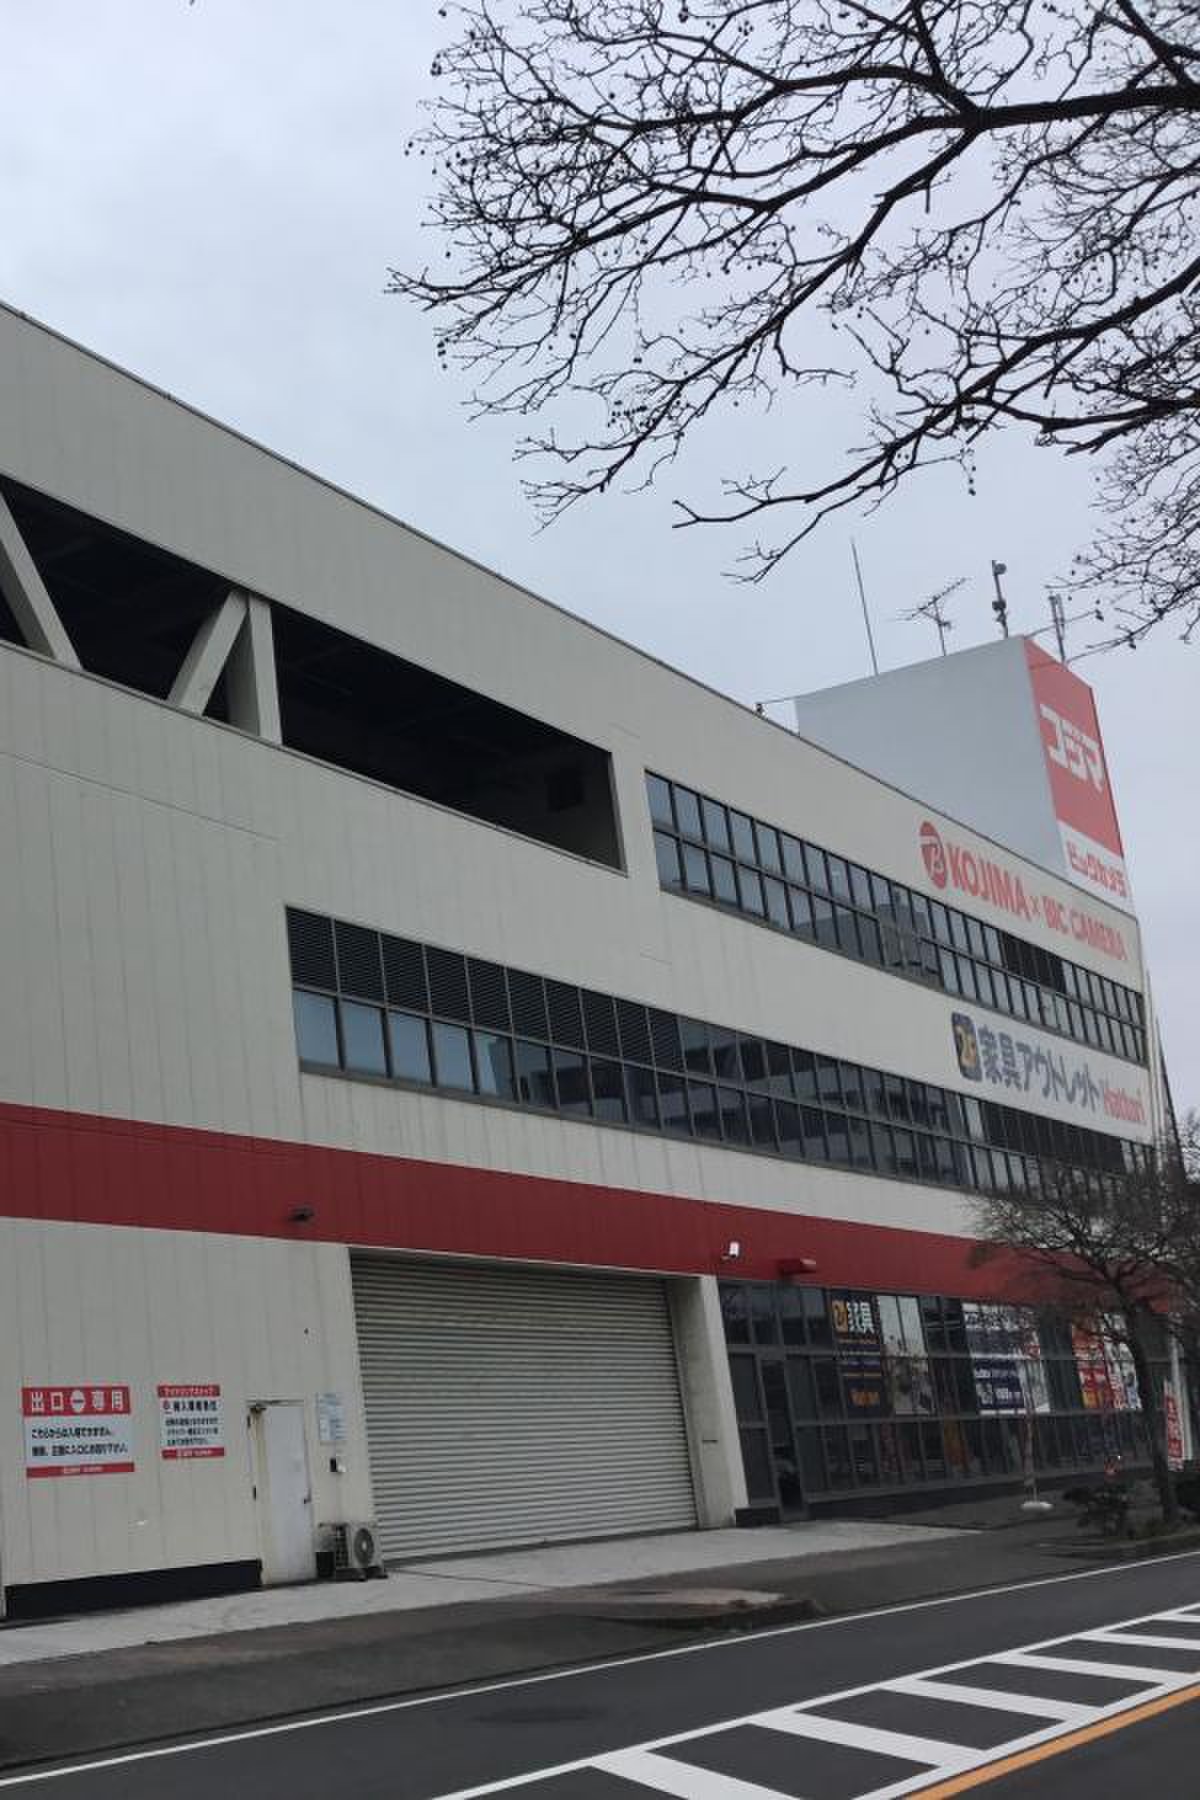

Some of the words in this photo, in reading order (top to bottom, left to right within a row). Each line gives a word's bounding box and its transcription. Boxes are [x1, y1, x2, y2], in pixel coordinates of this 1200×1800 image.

[1039, 703, 1104, 793] コジマ
[946, 842, 1032, 922] KOJIMA
[978, 1024, 1102, 1113] 家具アウトレット
[31, 1391, 64, 1413] 出口
